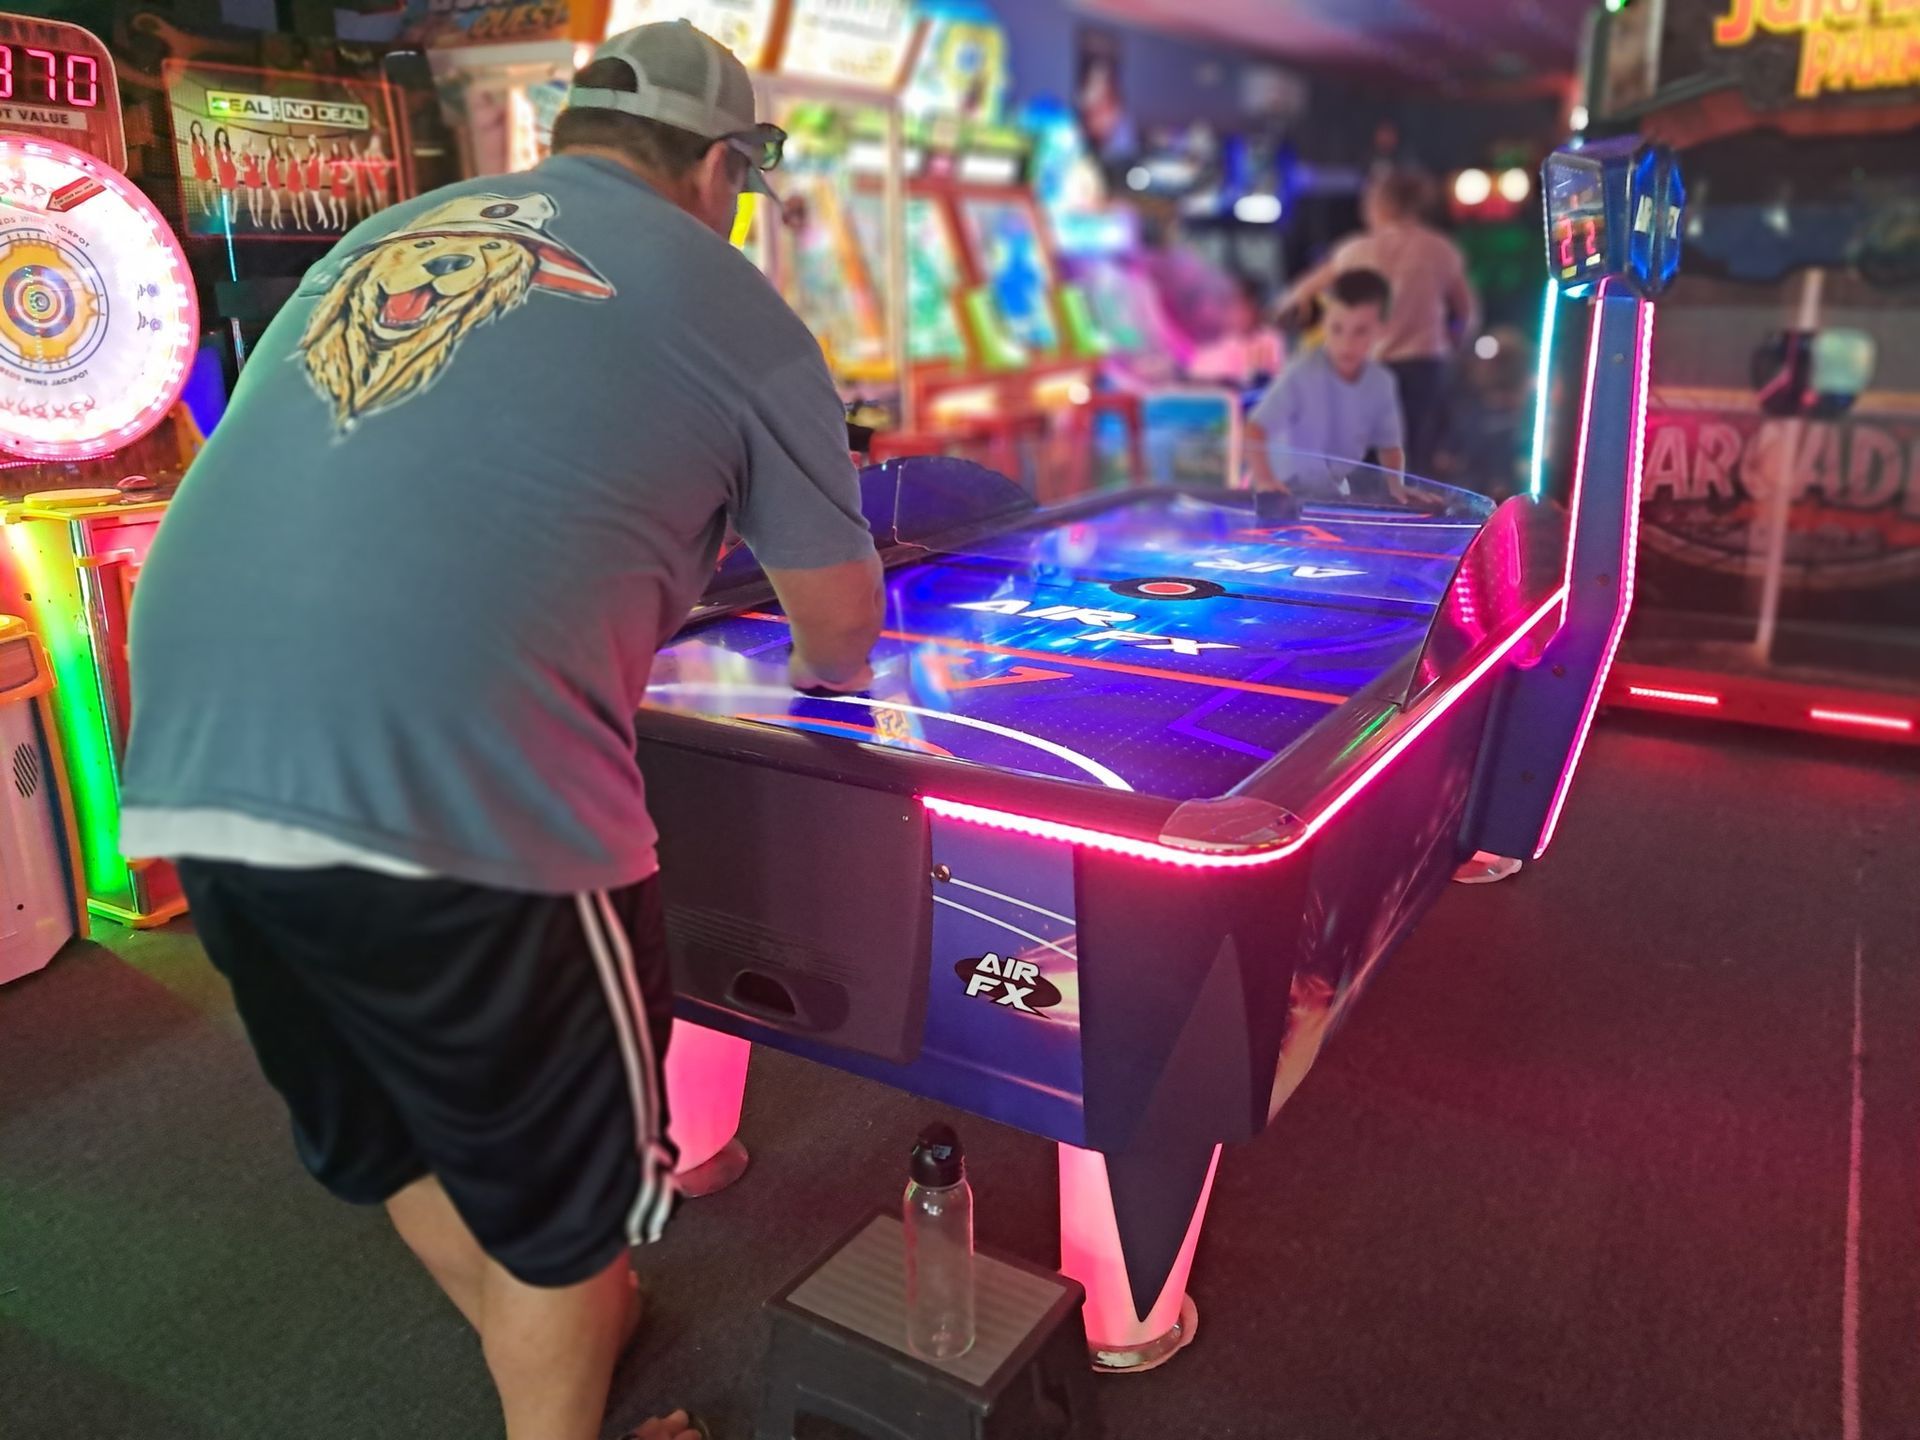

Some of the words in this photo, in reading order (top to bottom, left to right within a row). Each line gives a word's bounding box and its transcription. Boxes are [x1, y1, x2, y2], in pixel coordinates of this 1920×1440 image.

[18, 109, 69, 125] VALUE
[284, 103, 314, 119] NO
[316, 106, 364, 125] DEAL
[54, 223, 91, 248] ACKPOT
[24, 377, 48, 387] WINS
[51, 369, 89, 387] JACKPOT
[951, 599, 1137, 628] AIR
[975, 952, 1039, 986] AIR
[965, 973, 1048, 1017] FX
